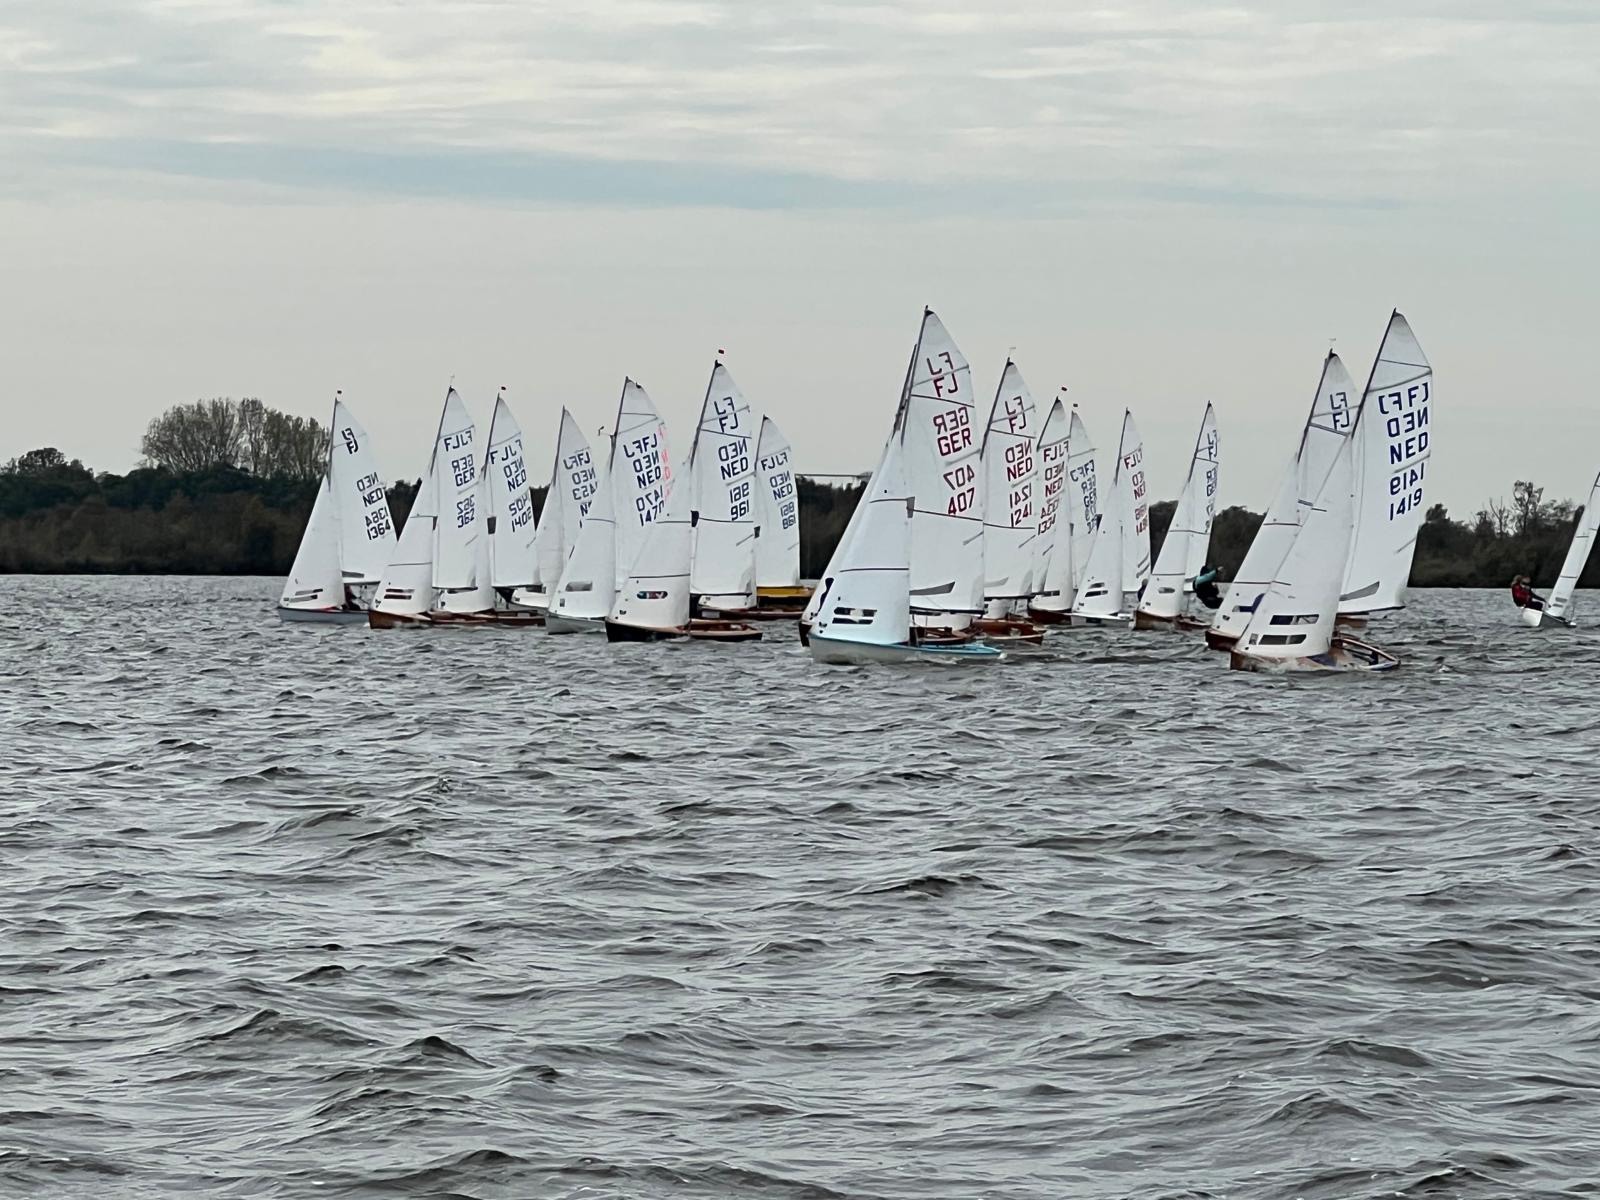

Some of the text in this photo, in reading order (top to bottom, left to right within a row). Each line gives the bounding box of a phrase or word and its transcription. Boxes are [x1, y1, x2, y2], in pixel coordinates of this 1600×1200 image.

[933, 371, 959, 398] FJ
[1408, 382, 1429, 407] FJ
[718, 413, 739, 433] FJ
[1009, 411, 1027, 434] FJ
[1333, 409, 1350, 430] FJ
[444, 435, 460, 452] FJ
[642, 433, 658, 452] FJ
[936, 427, 972, 457] GER
[1390, 432, 1428, 465] NED
[490, 446, 509, 464] FJ
[578, 451, 591, 466] FJ
[760, 456, 776, 471] FJ
[1043, 446, 1058, 463] FJ
[1124, 454, 1137, 470] FJ
[455, 467, 475, 487] GER
[720, 456, 749, 481] NED
[1006, 457, 1033, 482] NED
[1084, 459, 1095, 474] FJ
[507, 469, 527, 492] NED
[636, 466, 661, 489] NED
[1045, 477, 1063, 497] NED
[362, 487, 383, 507] NED
[772, 483, 793, 501] NED
[948, 487, 975, 516] 407
[730, 500, 749, 522] 961
[1010, 502, 1032, 528] 1241
[1390, 488, 1423, 521] 1419
[367, 519, 391, 540] 1364
